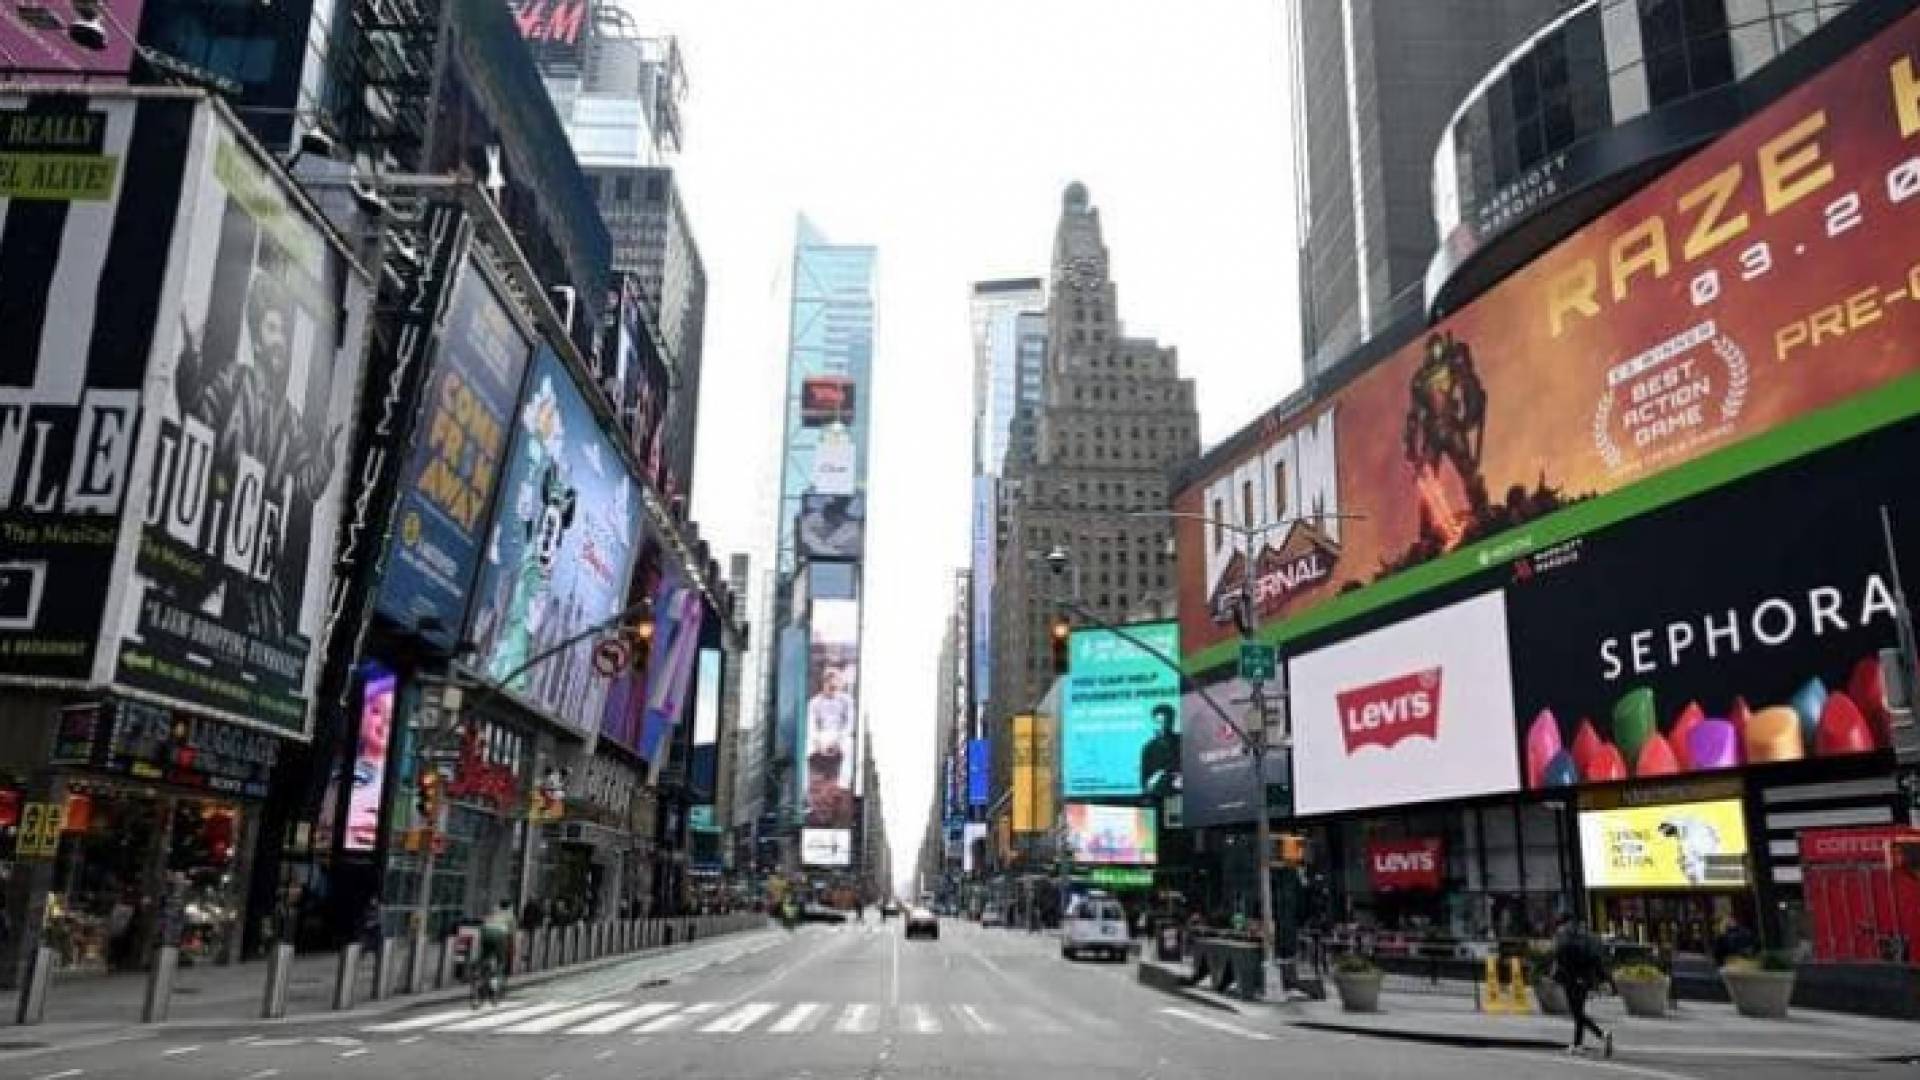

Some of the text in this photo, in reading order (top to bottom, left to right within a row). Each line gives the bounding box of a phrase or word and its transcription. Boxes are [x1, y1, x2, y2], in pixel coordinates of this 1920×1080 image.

[9, 115, 95, 144] REALLY
[29, 159, 109, 191] ALIVE!
[1548, 110, 1836, 338] RAZE
[1622, 374, 1711, 432] ACTION
[1632, 358, 1697, 404] BEST
[1635, 402, 1704, 447] GAME
[1600, 574, 1898, 681] SEPHORA
